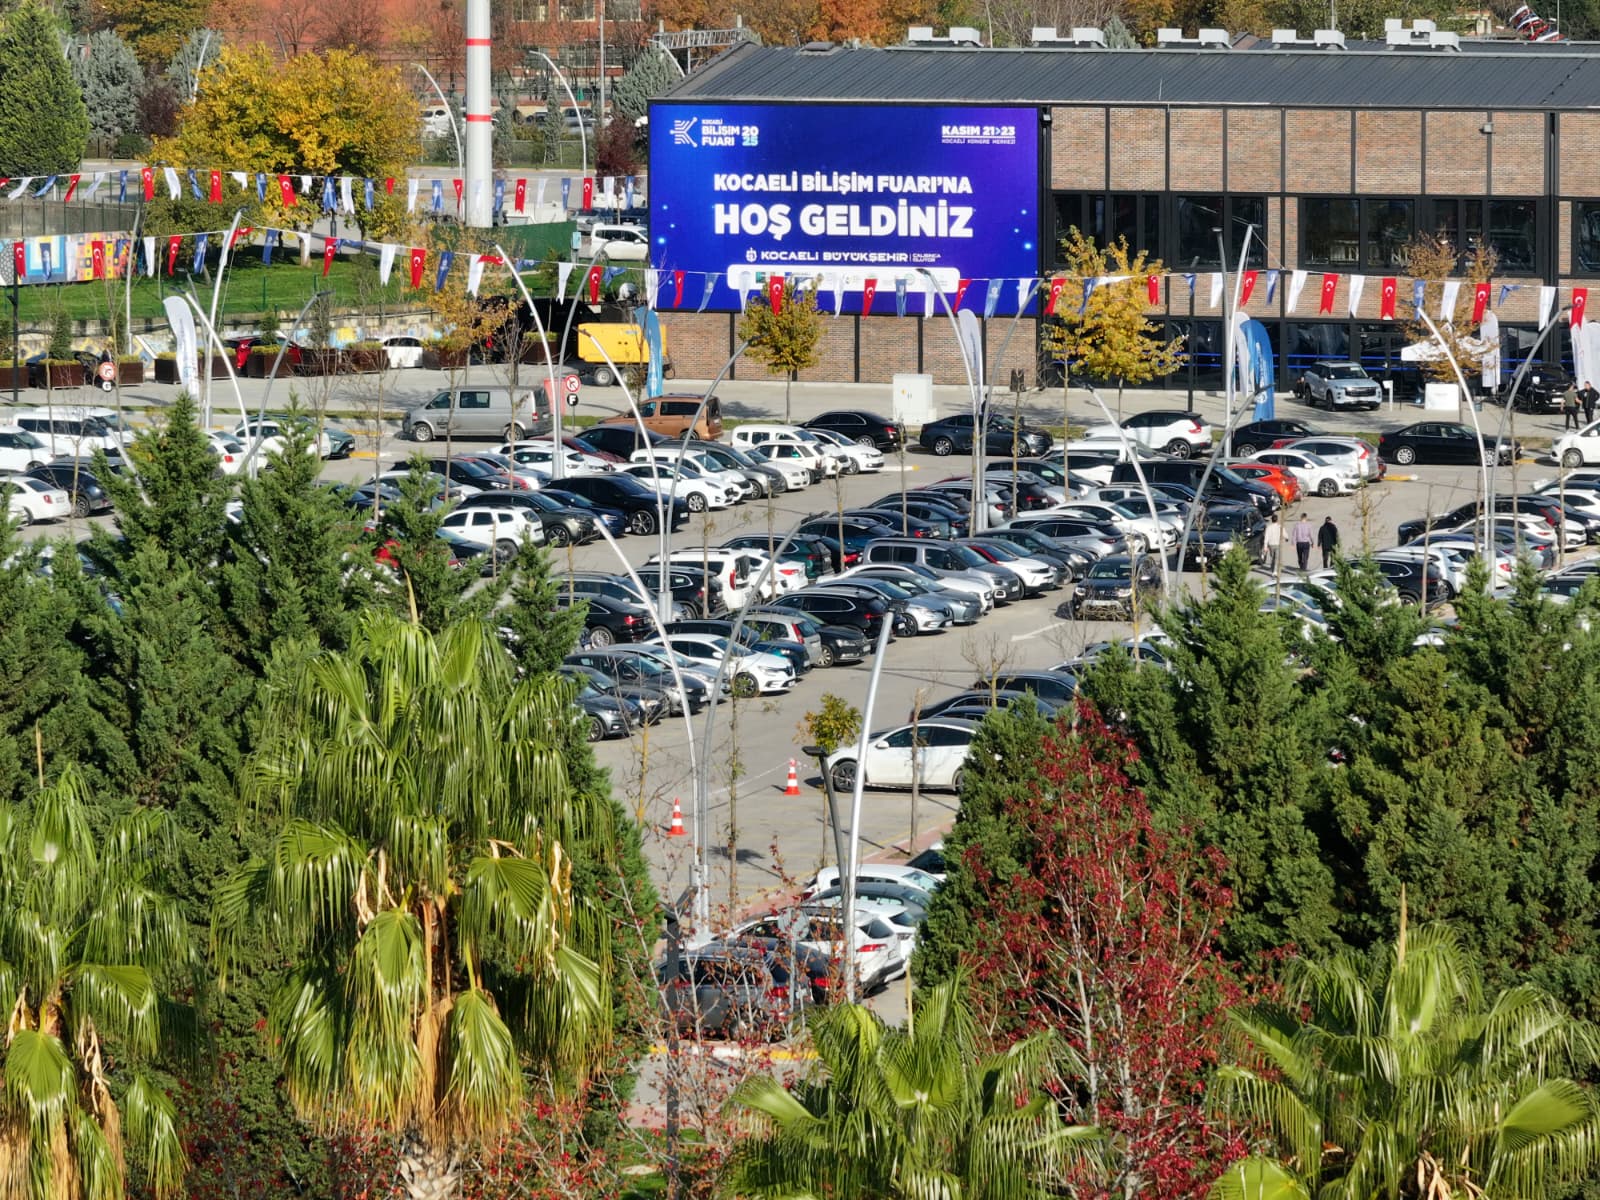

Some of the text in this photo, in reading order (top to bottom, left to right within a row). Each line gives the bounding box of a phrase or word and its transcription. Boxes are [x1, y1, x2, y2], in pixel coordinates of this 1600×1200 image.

[742, 126, 759, 136] 20
[942, 125, 980, 136] KASIM
[701, 136, 735, 146] FUARI
[742, 136, 759, 146] 25
[713, 170, 973, 196] KOCAELİ BİLİŞİM FUARI'NA
[714, 198, 974, 241] HOŞ GELDİNİZ
[760, 251, 909, 263] KOCAELİ BÜYÜKŞEHİR
